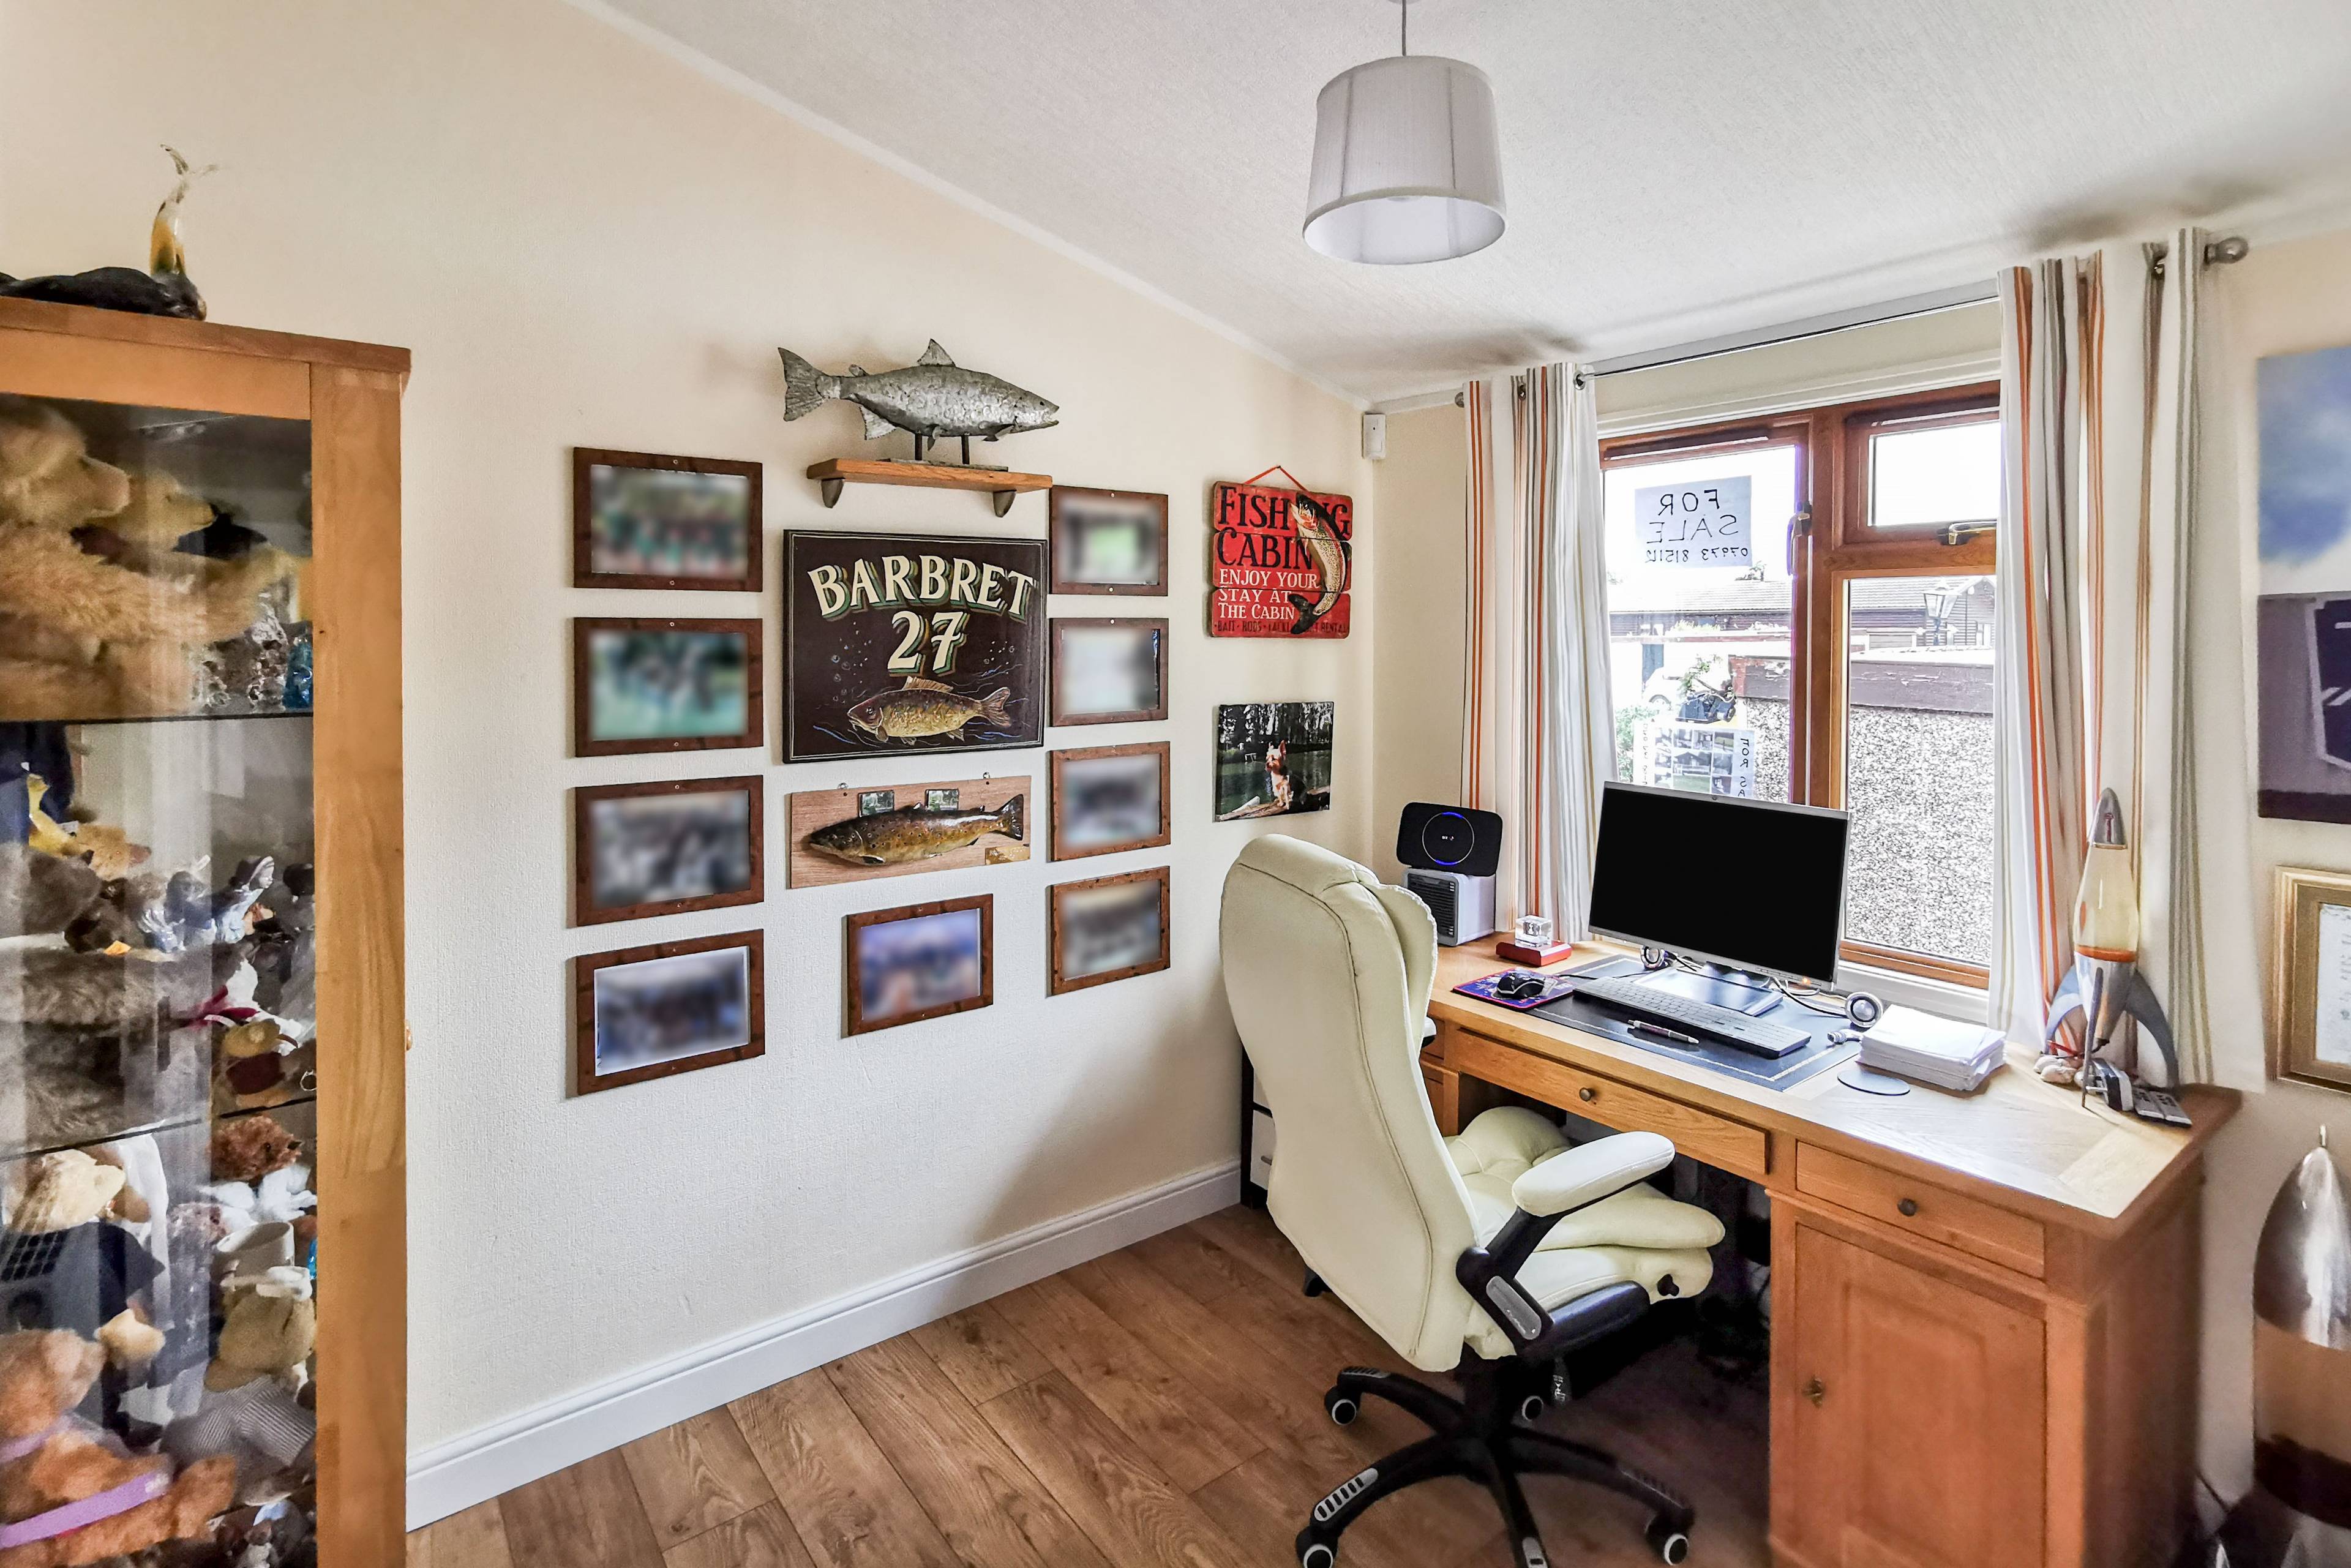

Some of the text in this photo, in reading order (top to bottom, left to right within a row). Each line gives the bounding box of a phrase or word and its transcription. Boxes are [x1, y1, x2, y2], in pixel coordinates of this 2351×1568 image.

[1218, 486, 1351, 536] FISHG
[1217, 527, 1313, 569] CABIN
[807, 555, 1037, 620] BARBRET
[1218, 586, 1292, 603] STAY AT
[1219, 568, 1319, 588] ENJOY YOUR
[1218, 602, 1295, 620] THE CABIN
[887, 610, 970, 676] 27
